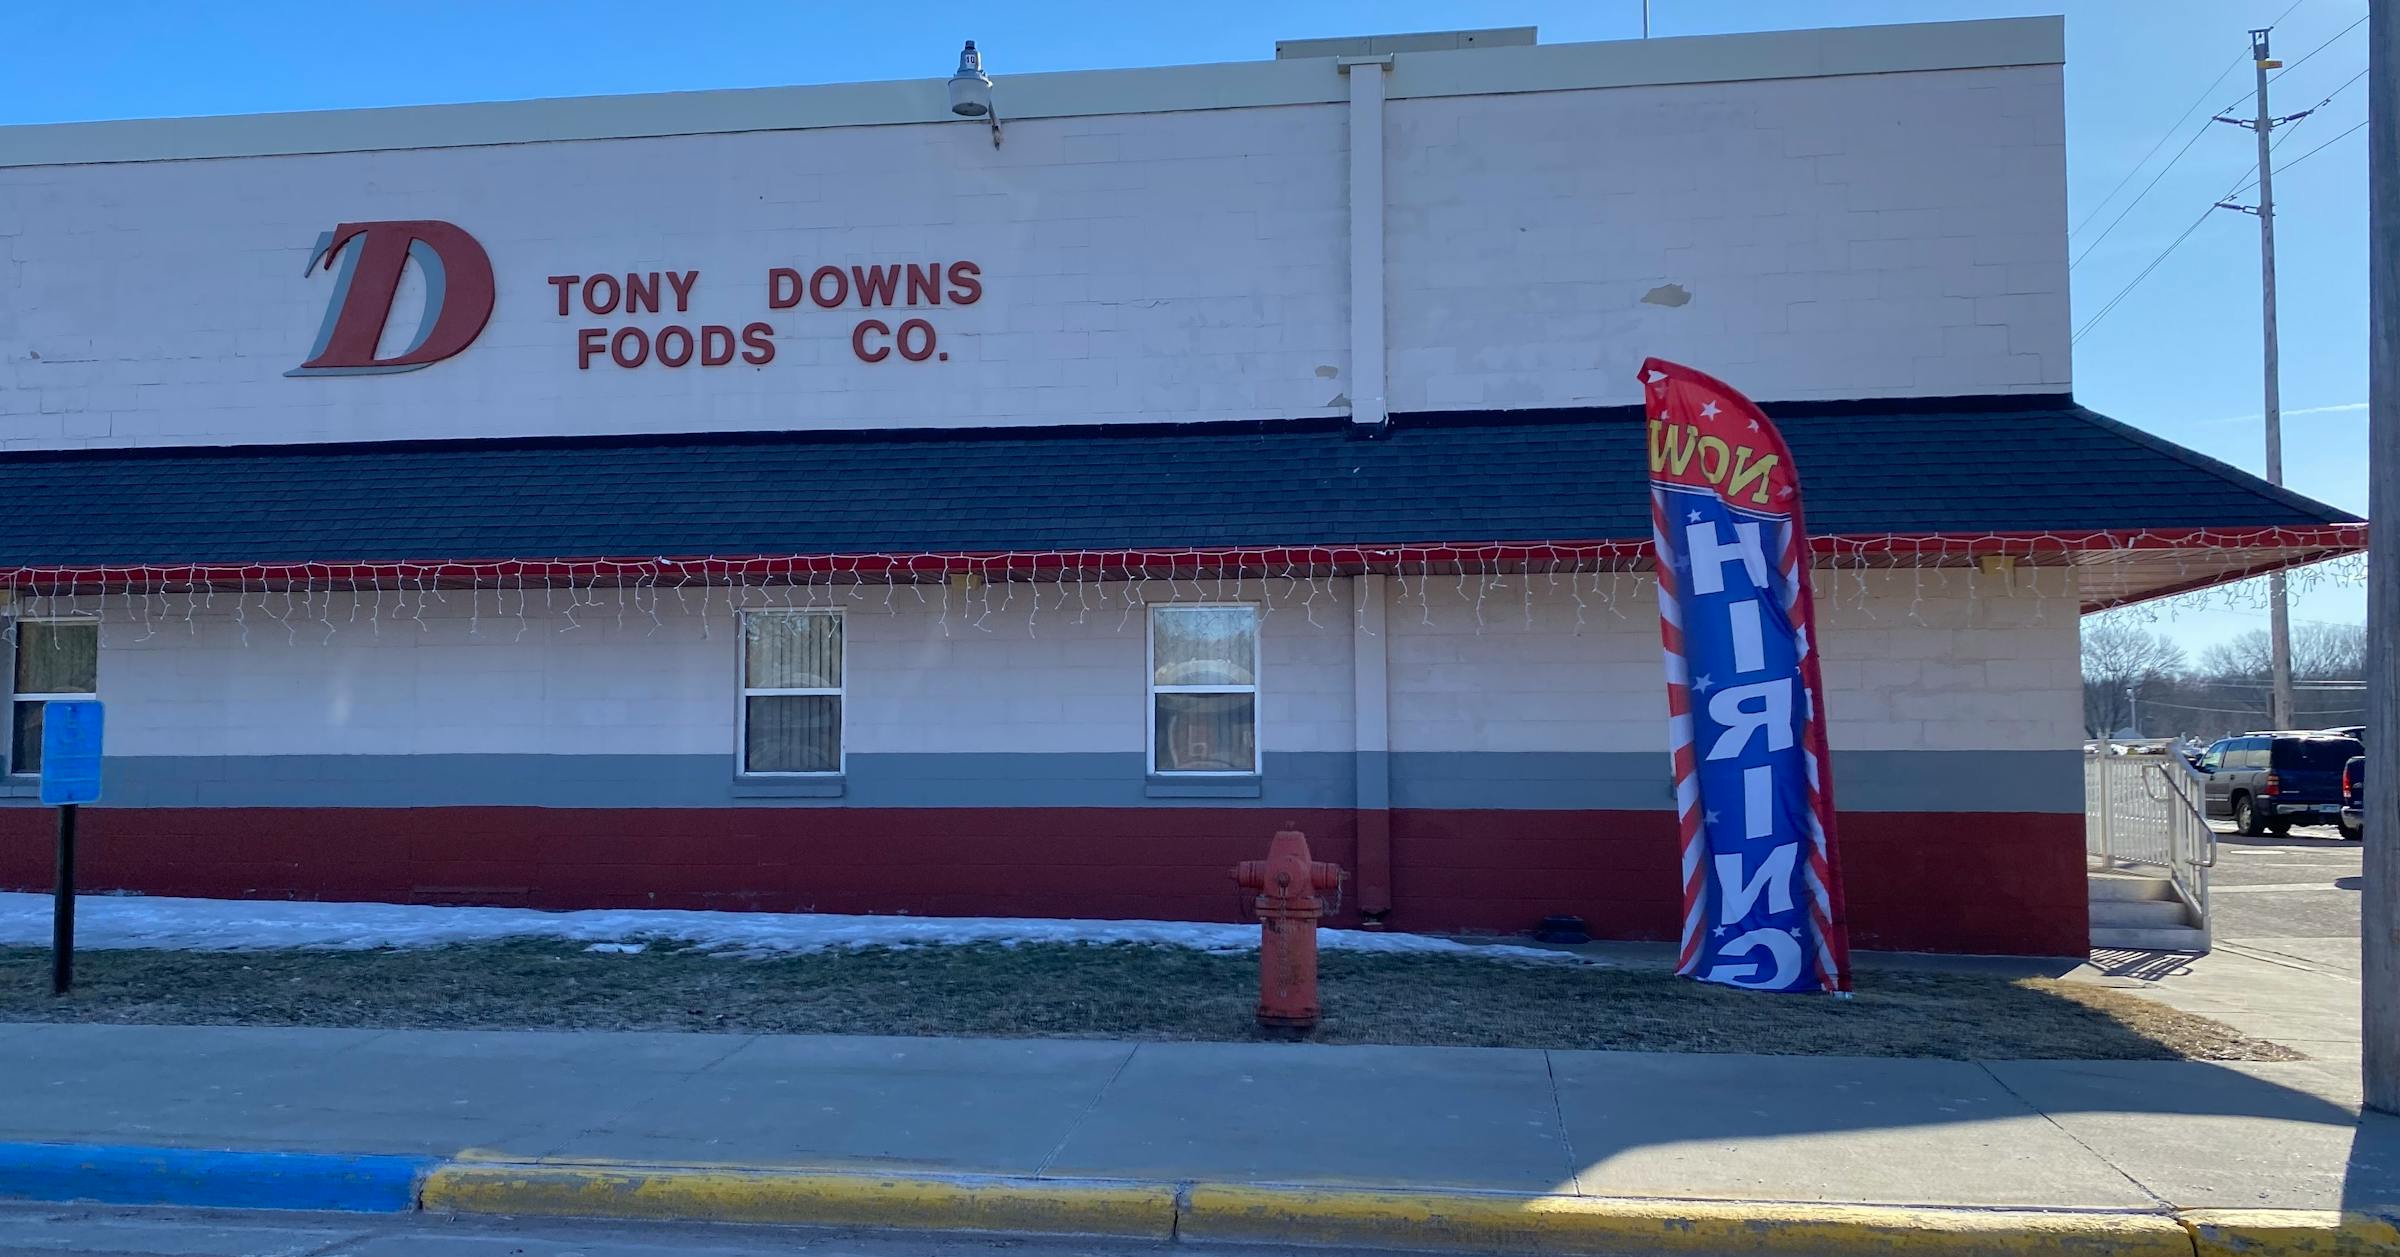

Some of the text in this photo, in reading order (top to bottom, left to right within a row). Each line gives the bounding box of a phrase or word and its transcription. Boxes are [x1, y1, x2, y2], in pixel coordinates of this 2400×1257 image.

[548, 260, 983, 316] TONY DOWNS
[578, 319, 948, 370] FOODS CO.
